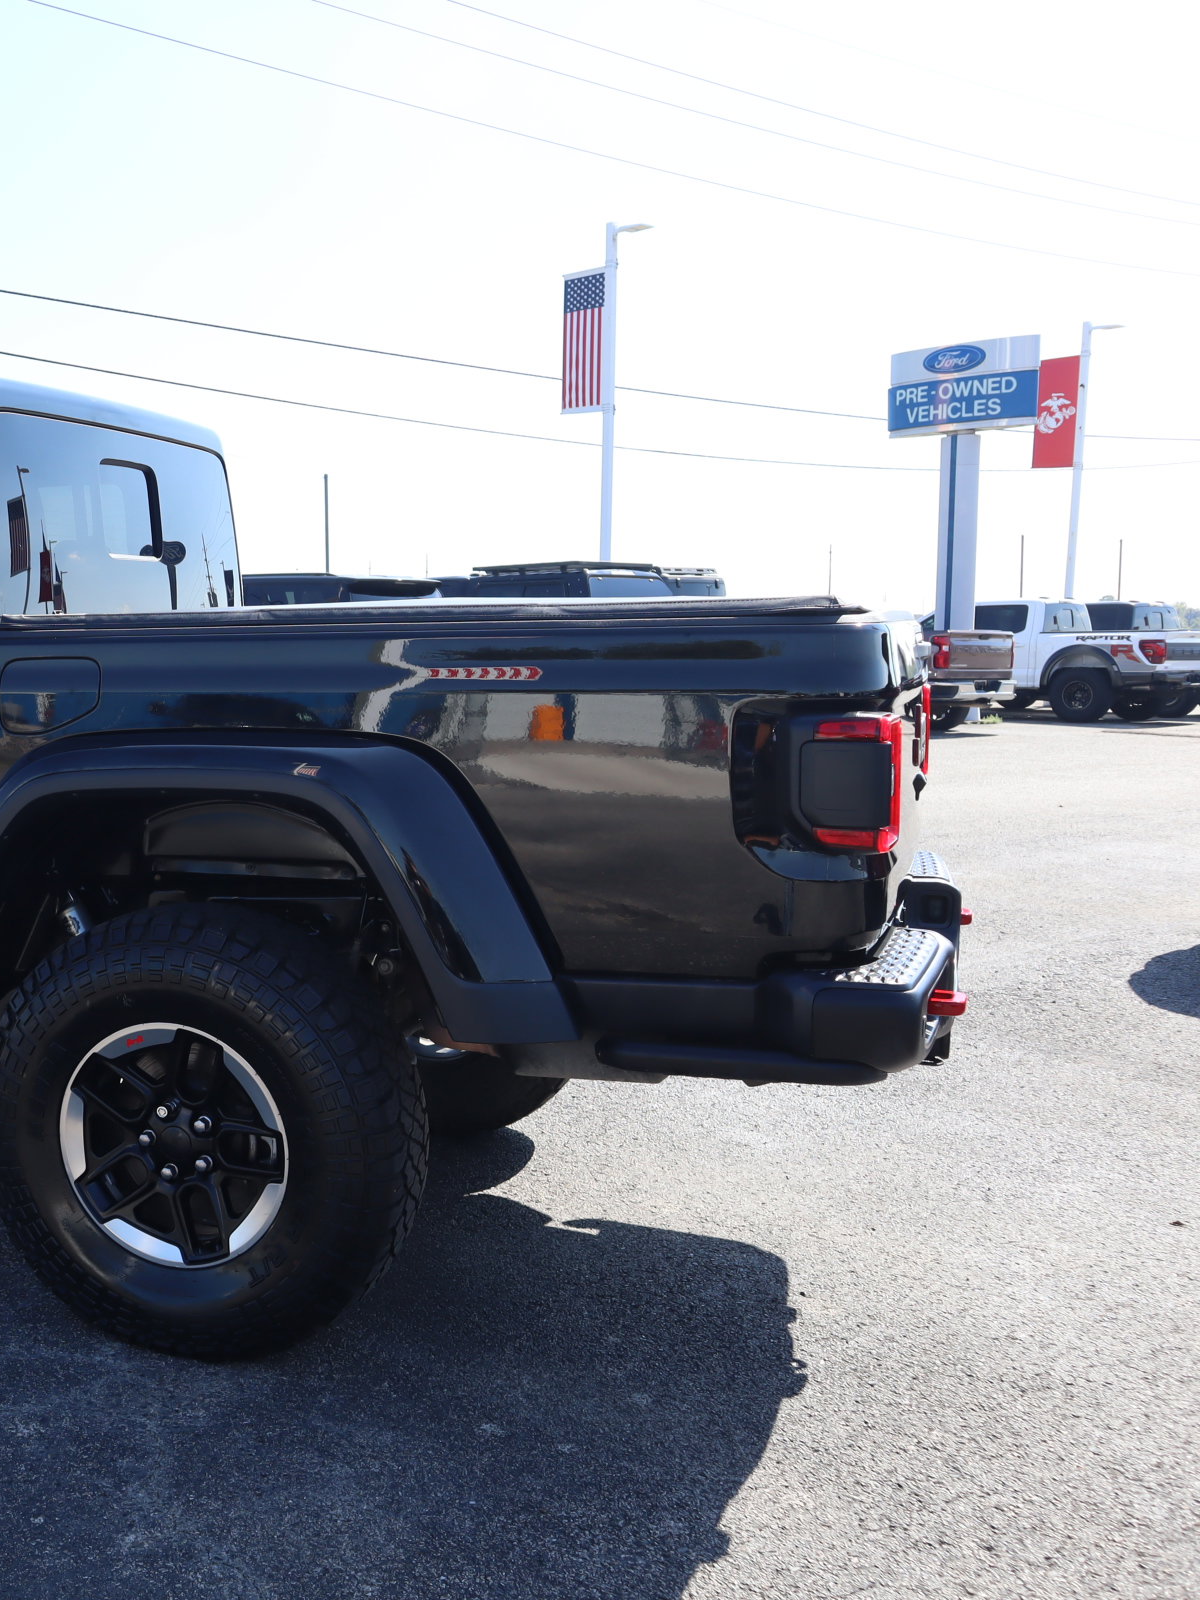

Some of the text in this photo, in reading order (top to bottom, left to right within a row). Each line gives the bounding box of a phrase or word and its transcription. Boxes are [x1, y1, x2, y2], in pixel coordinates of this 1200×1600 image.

[934, 350, 970, 369] Ford
[896, 376, 1017, 405] PRE-OWNED
[906, 398, 1001, 423] VEHICLES
